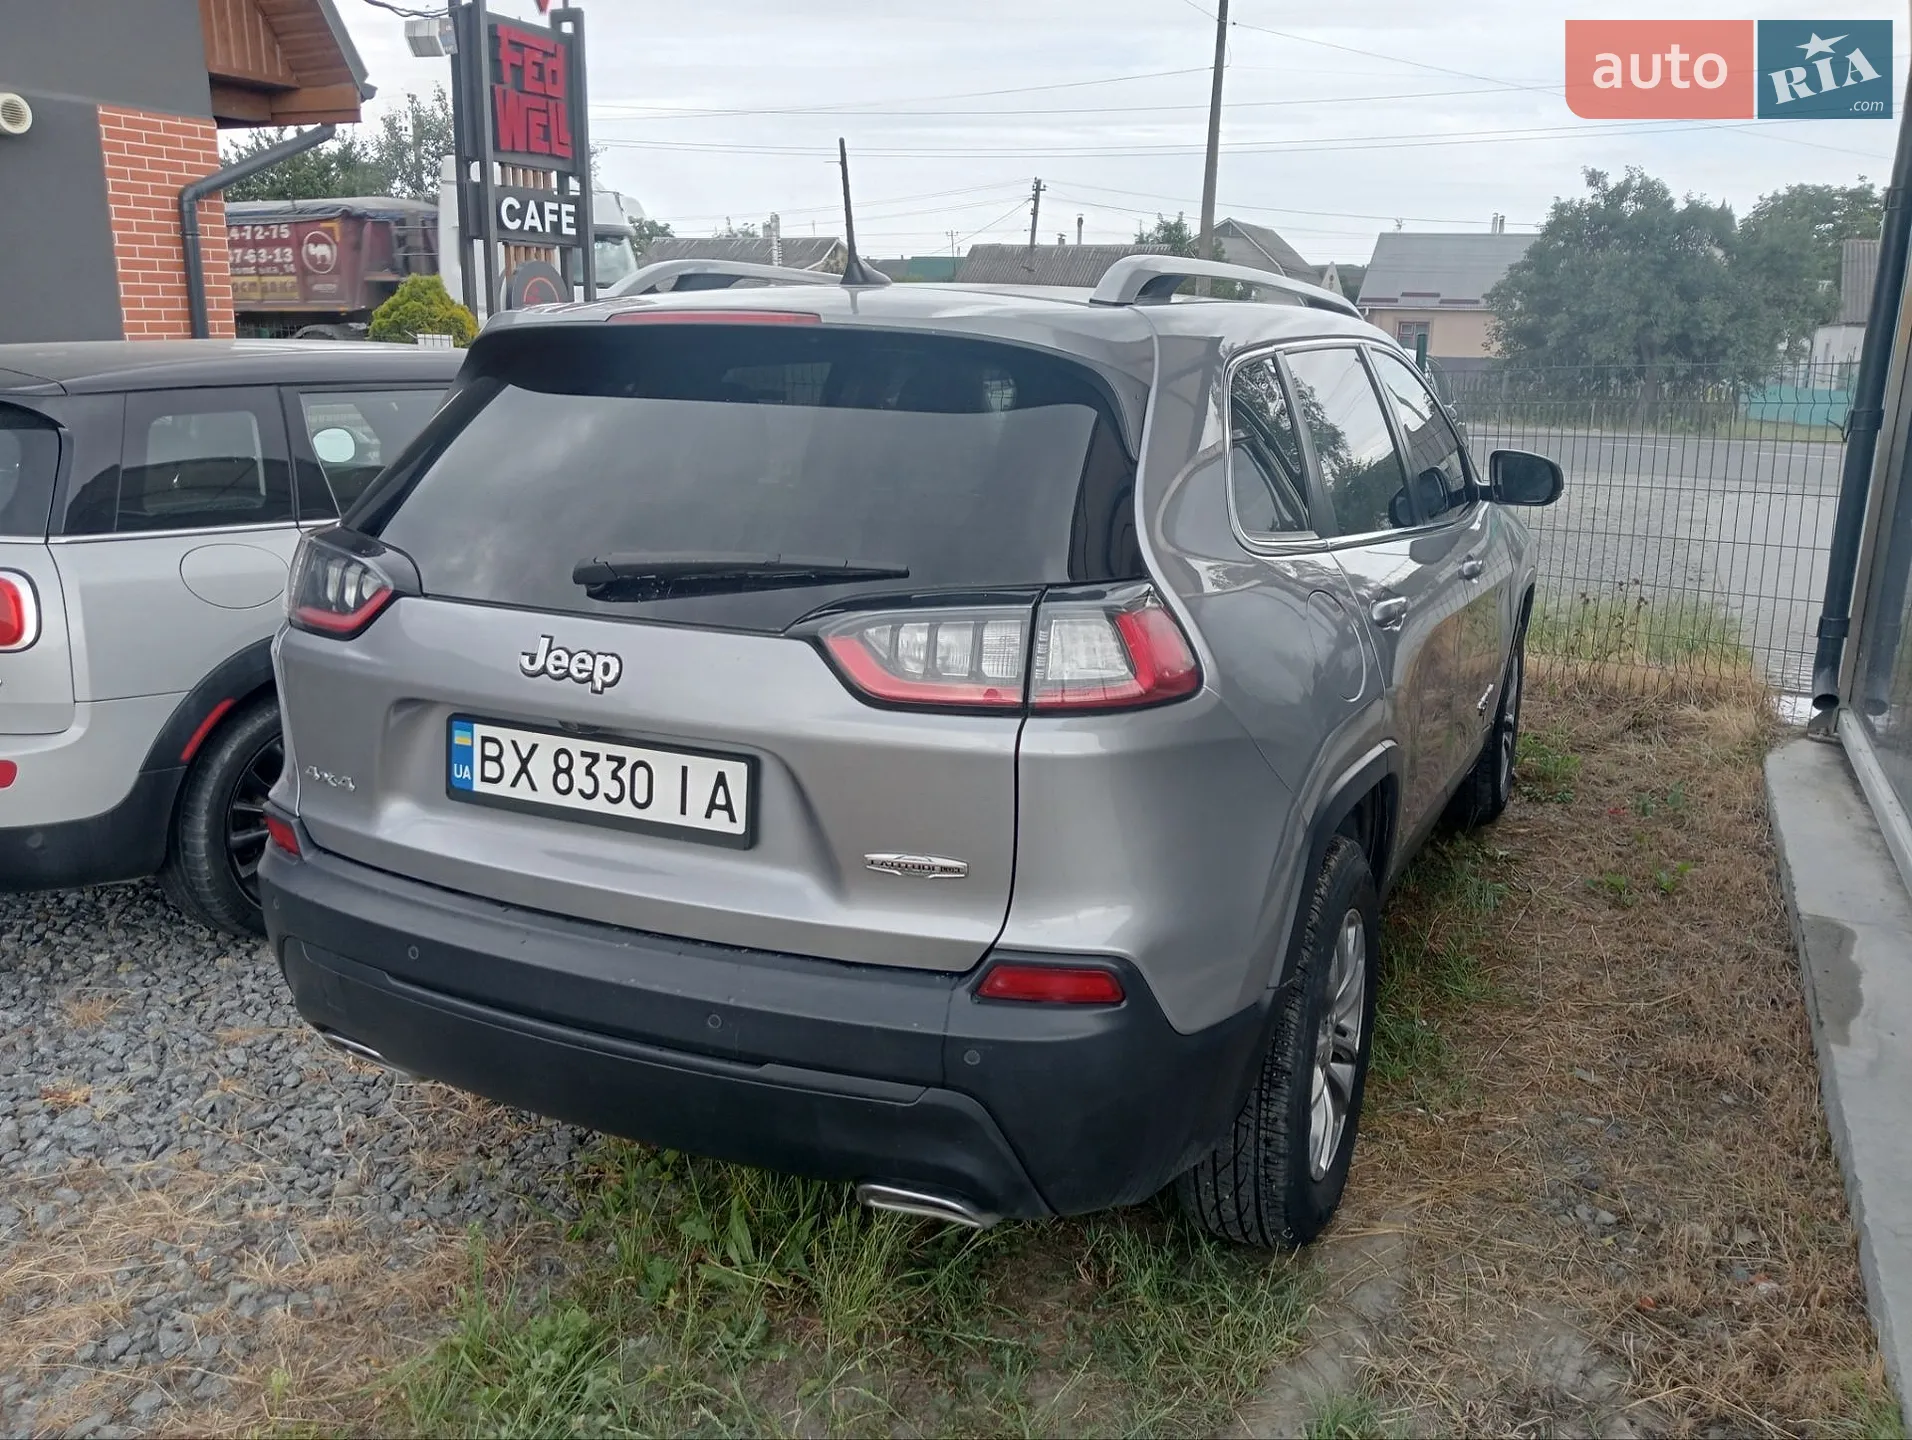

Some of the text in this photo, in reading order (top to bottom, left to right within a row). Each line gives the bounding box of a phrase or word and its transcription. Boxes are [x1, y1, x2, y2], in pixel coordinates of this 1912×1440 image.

[501, 196, 577, 236] CAFE
[519, 634, 623, 695] Jeep
[453, 763, 472, 781] UA
[480, 735, 539, 792] BX
[552, 747, 654, 810] 8330
